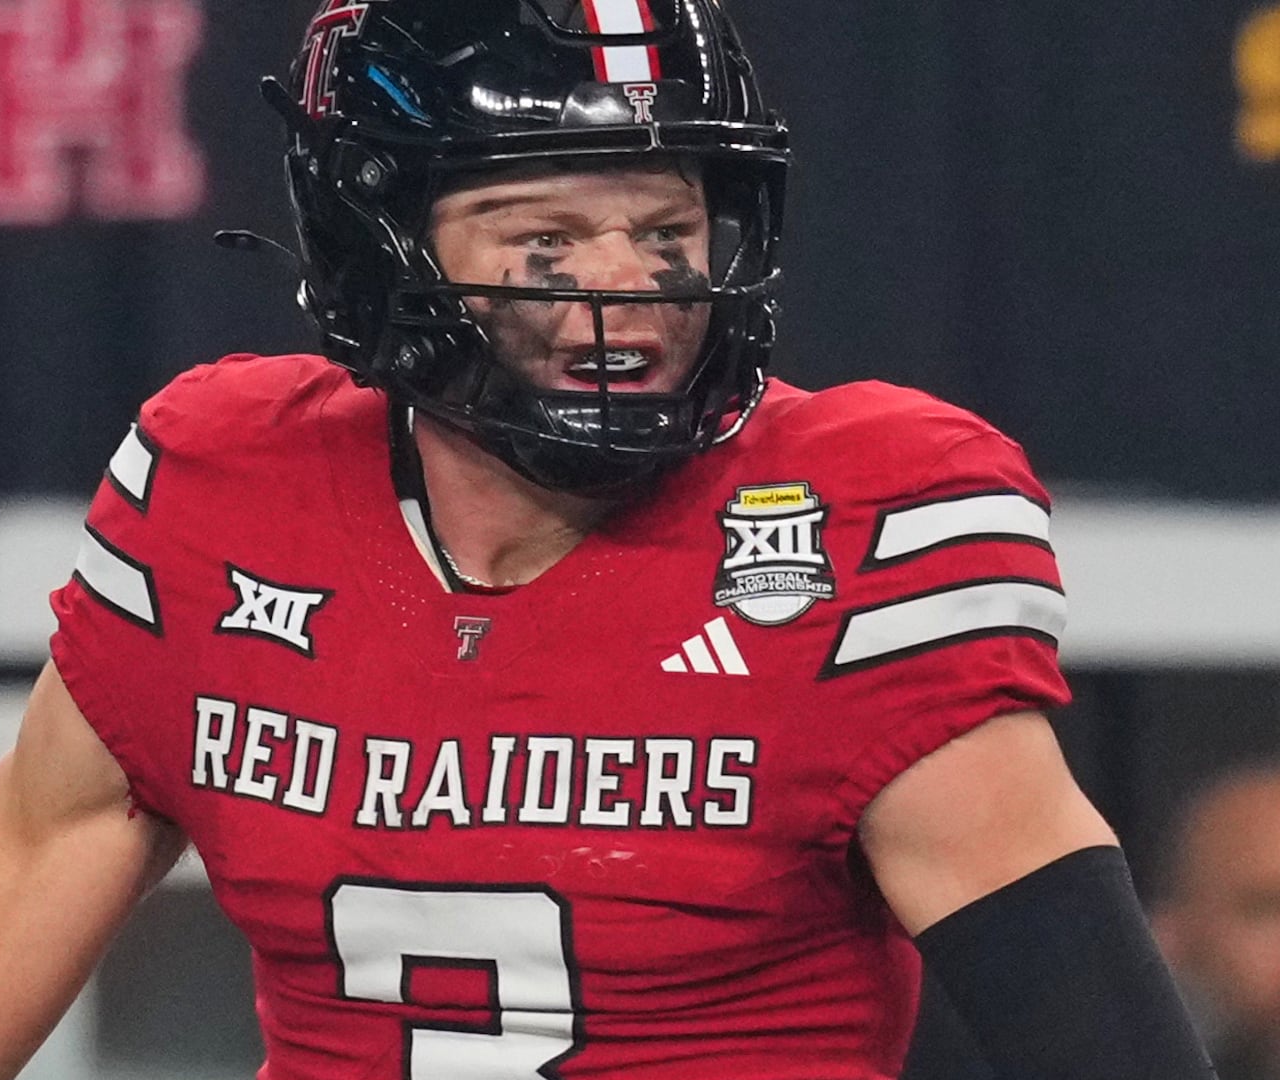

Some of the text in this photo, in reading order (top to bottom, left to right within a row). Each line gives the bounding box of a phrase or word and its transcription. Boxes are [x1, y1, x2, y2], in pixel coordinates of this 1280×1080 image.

[723, 511, 825, 569] XII
[221, 567, 324, 650] XII
[715, 581, 832, 601] CHAMPIONSHIP
[735, 572, 812, 587] FOOTBALL
[191, 695, 756, 827] RED RAIDERS
